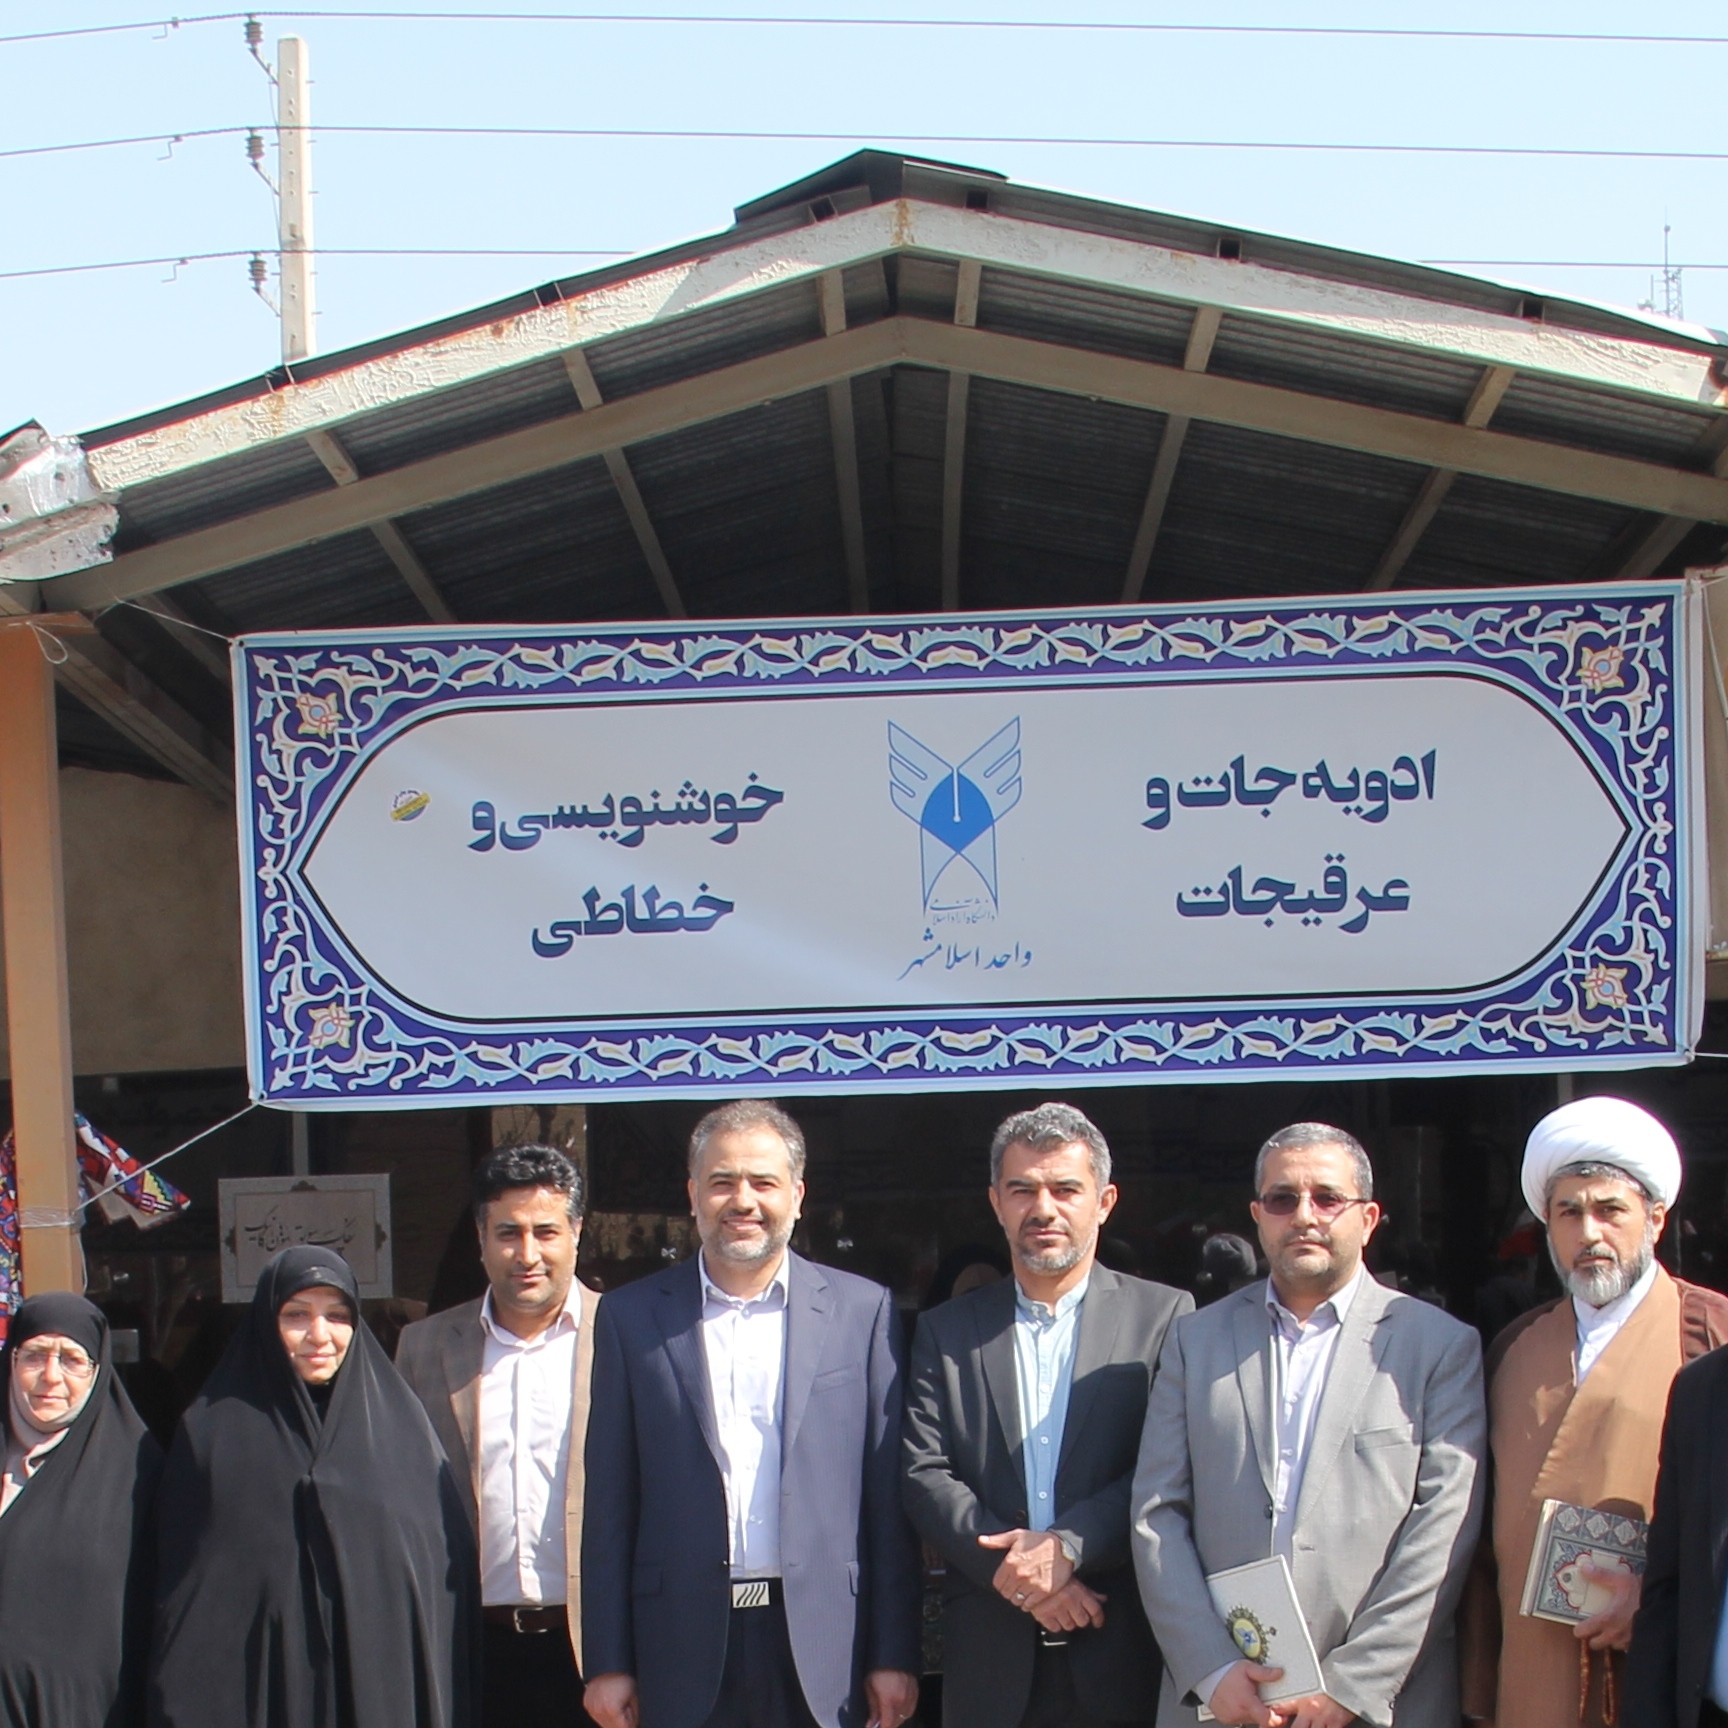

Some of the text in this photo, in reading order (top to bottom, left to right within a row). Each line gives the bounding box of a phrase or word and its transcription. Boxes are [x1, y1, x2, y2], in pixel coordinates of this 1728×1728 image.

[468, 801, 496, 853] و
[500, 773, 785, 851] خوشنویسی
[1142, 749, 1437, 831] ادویه جات و
[532, 882, 735, 959] خطاطی
[1177, 853, 1410, 934] عرقیجات
[895, 927, 1032, 981] واحد اسلامشهر
